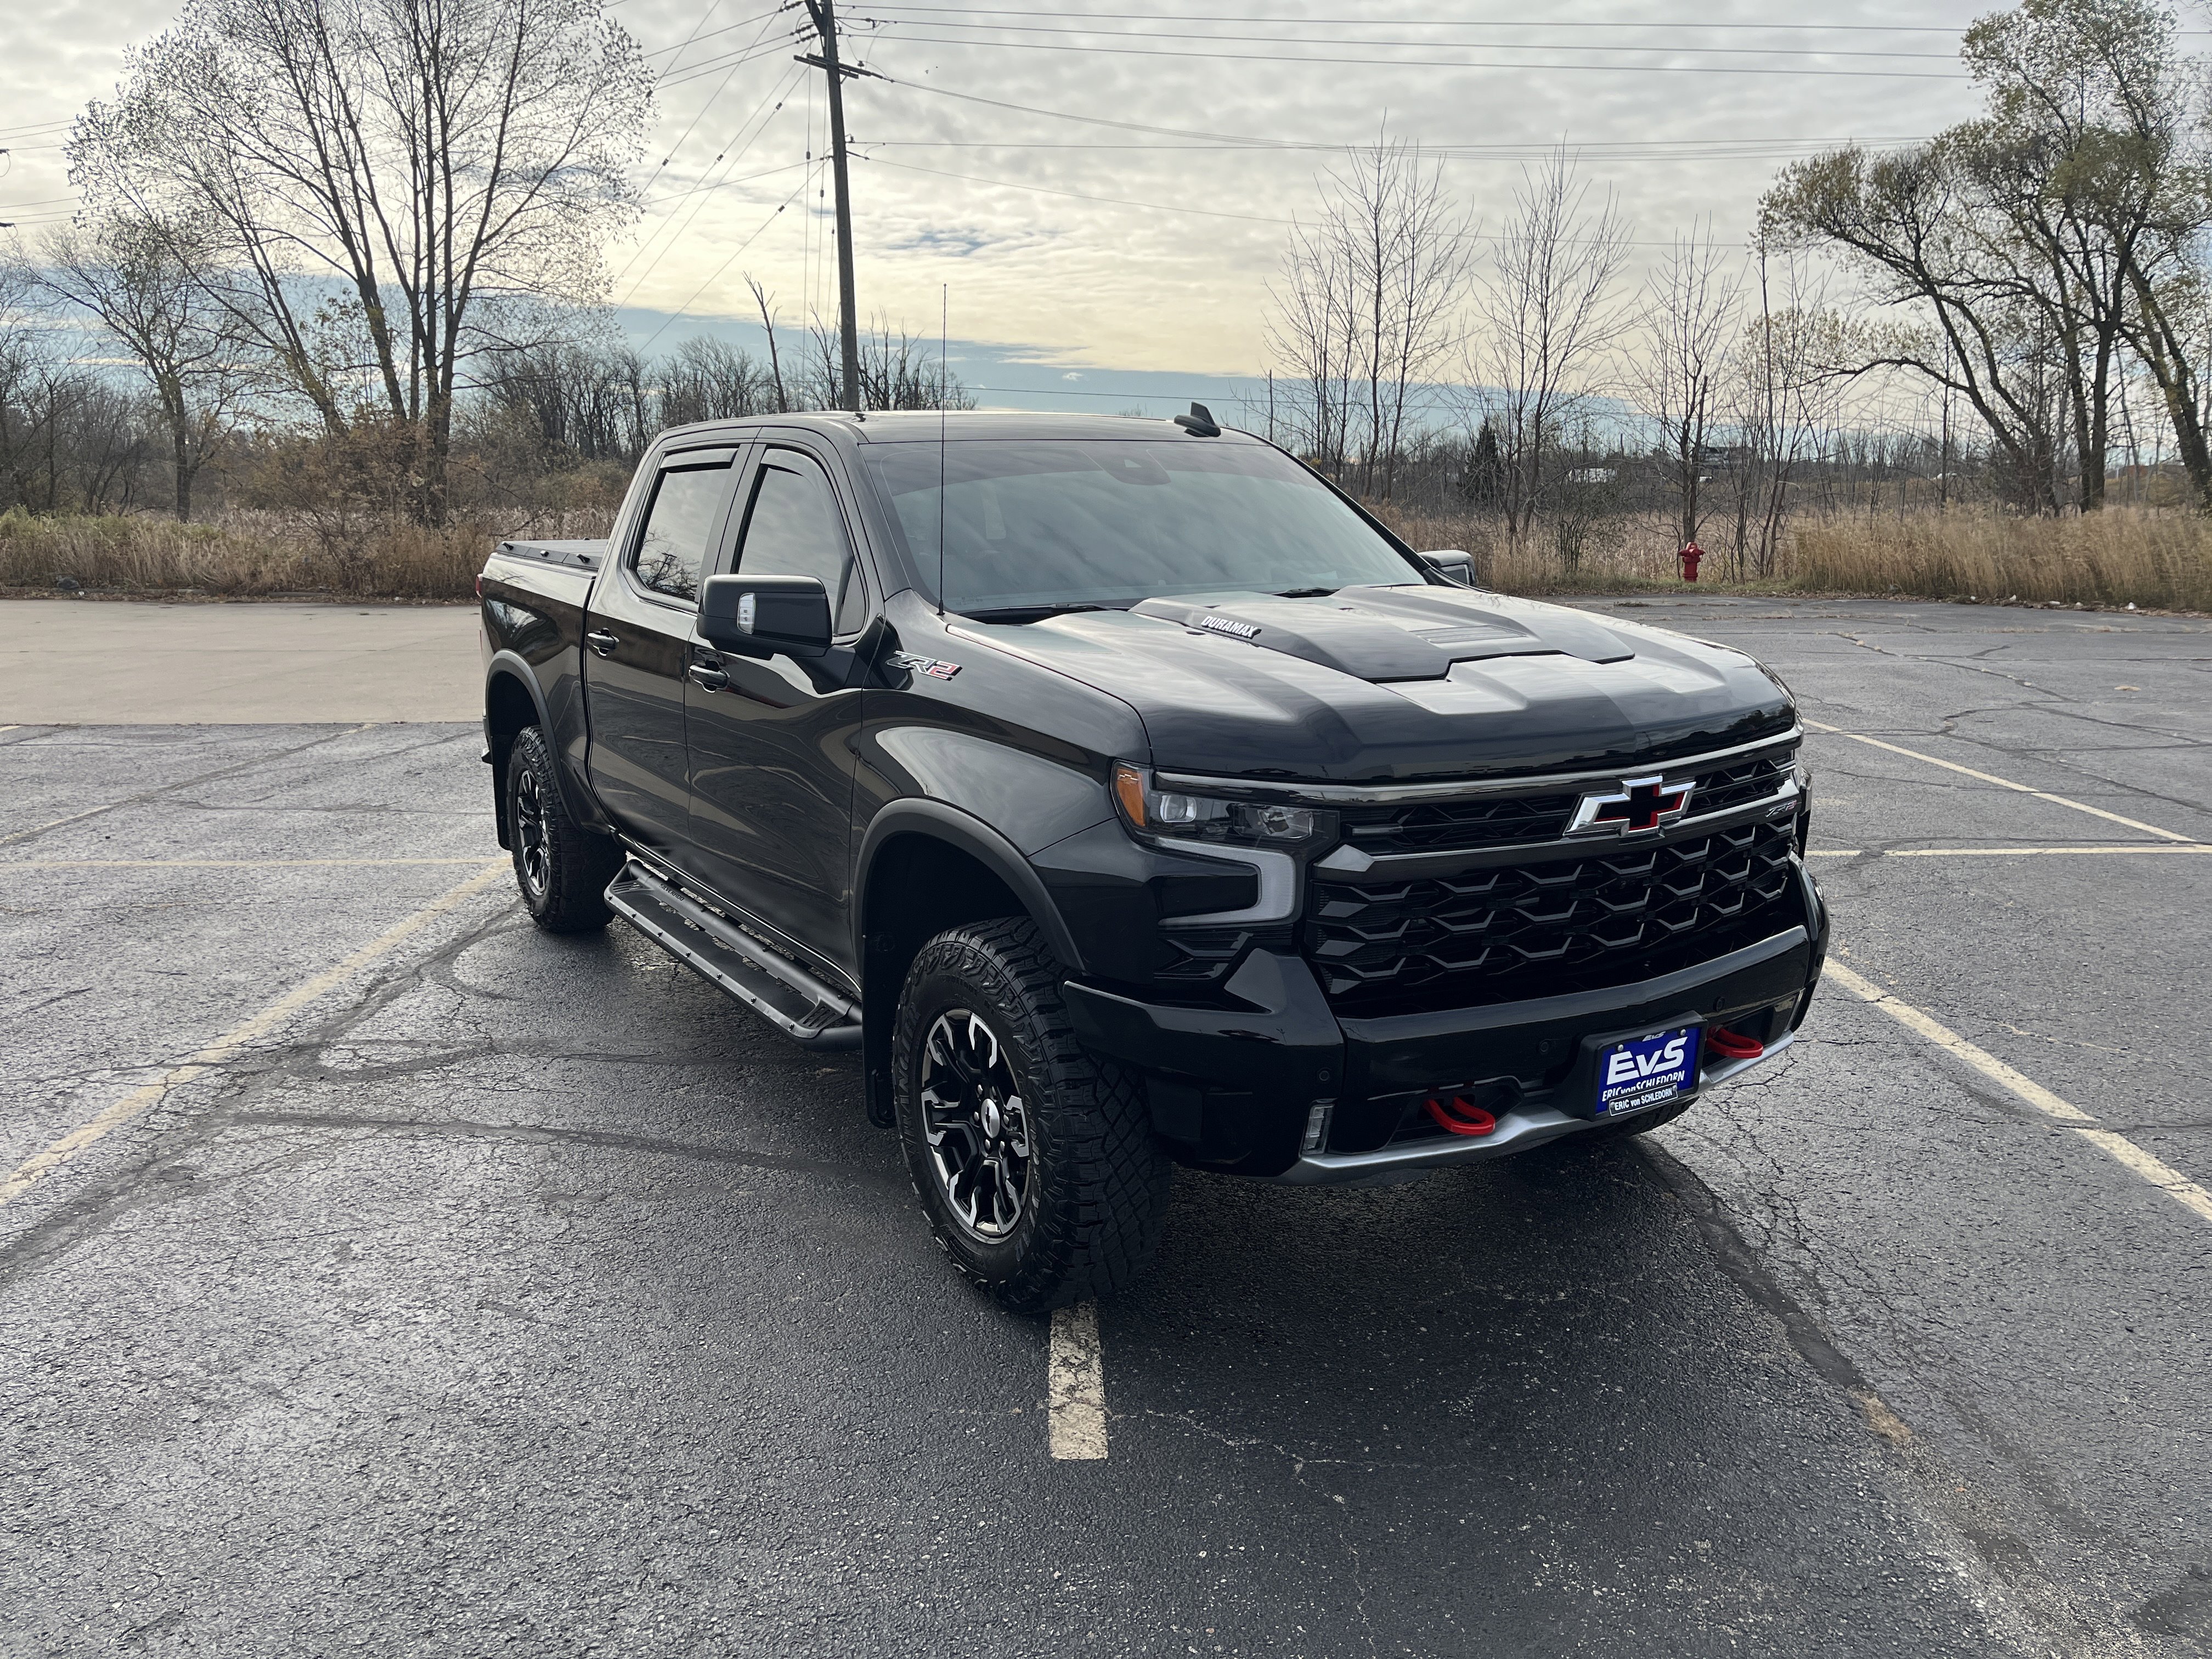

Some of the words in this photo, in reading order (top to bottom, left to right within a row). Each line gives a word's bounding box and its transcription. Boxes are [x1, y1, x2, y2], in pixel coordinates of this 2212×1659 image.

[1201, 616, 1258, 637] DURAMAX
[885, 651, 961, 680] ZR2
[1615, 1099, 1629, 1110] ERIC
[1630, 1098, 1640, 1107] von
[1641, 1087, 1672, 1103] SCHLEDORN
